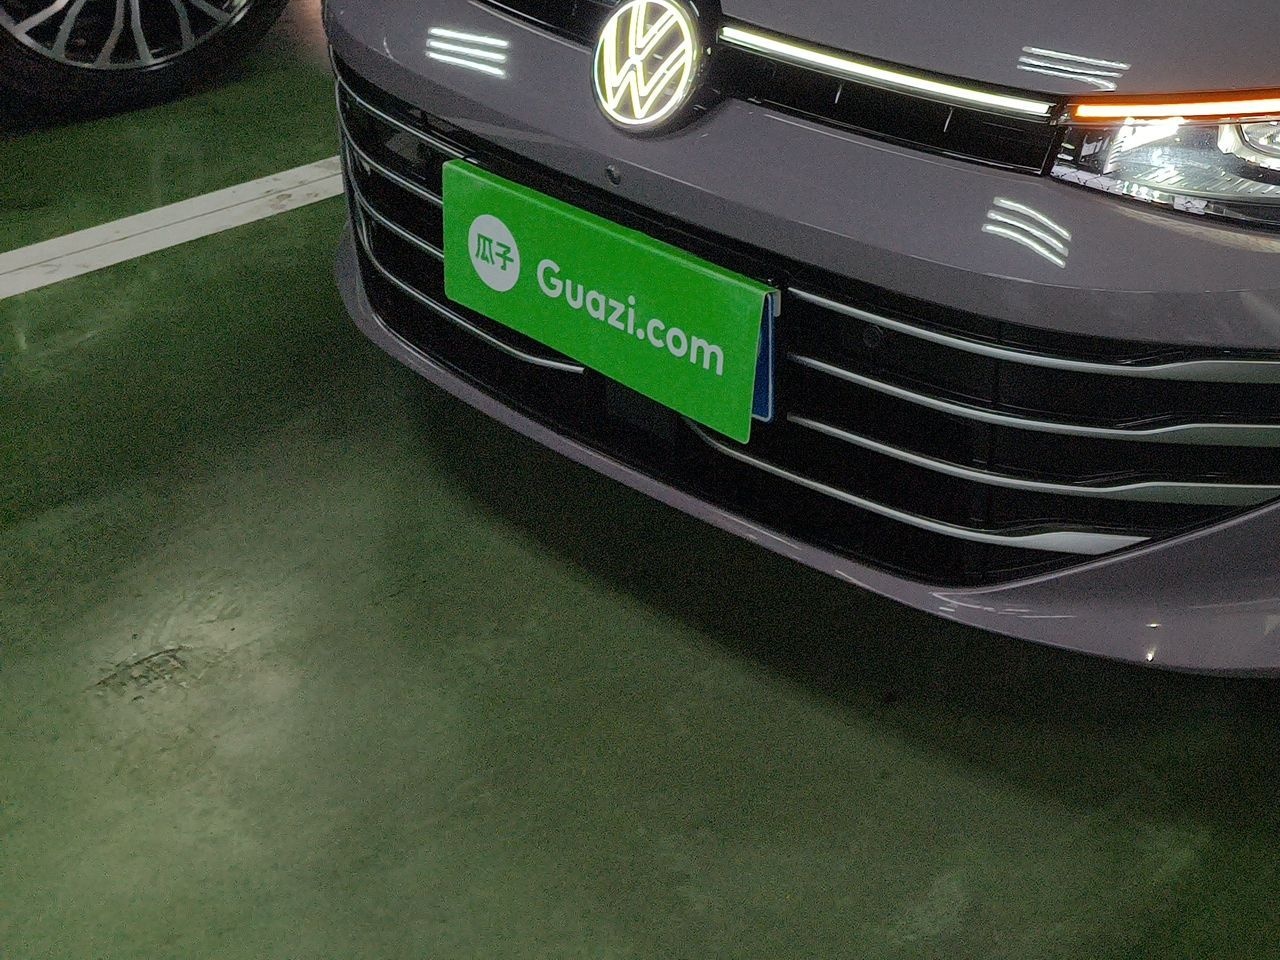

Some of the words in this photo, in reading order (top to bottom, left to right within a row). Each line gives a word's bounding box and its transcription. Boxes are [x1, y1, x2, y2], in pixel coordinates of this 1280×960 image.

[596, 0, 691, 122] VW
[475, 233, 514, 271] 瓜子
[536, 259, 725, 377] Guazi.com
